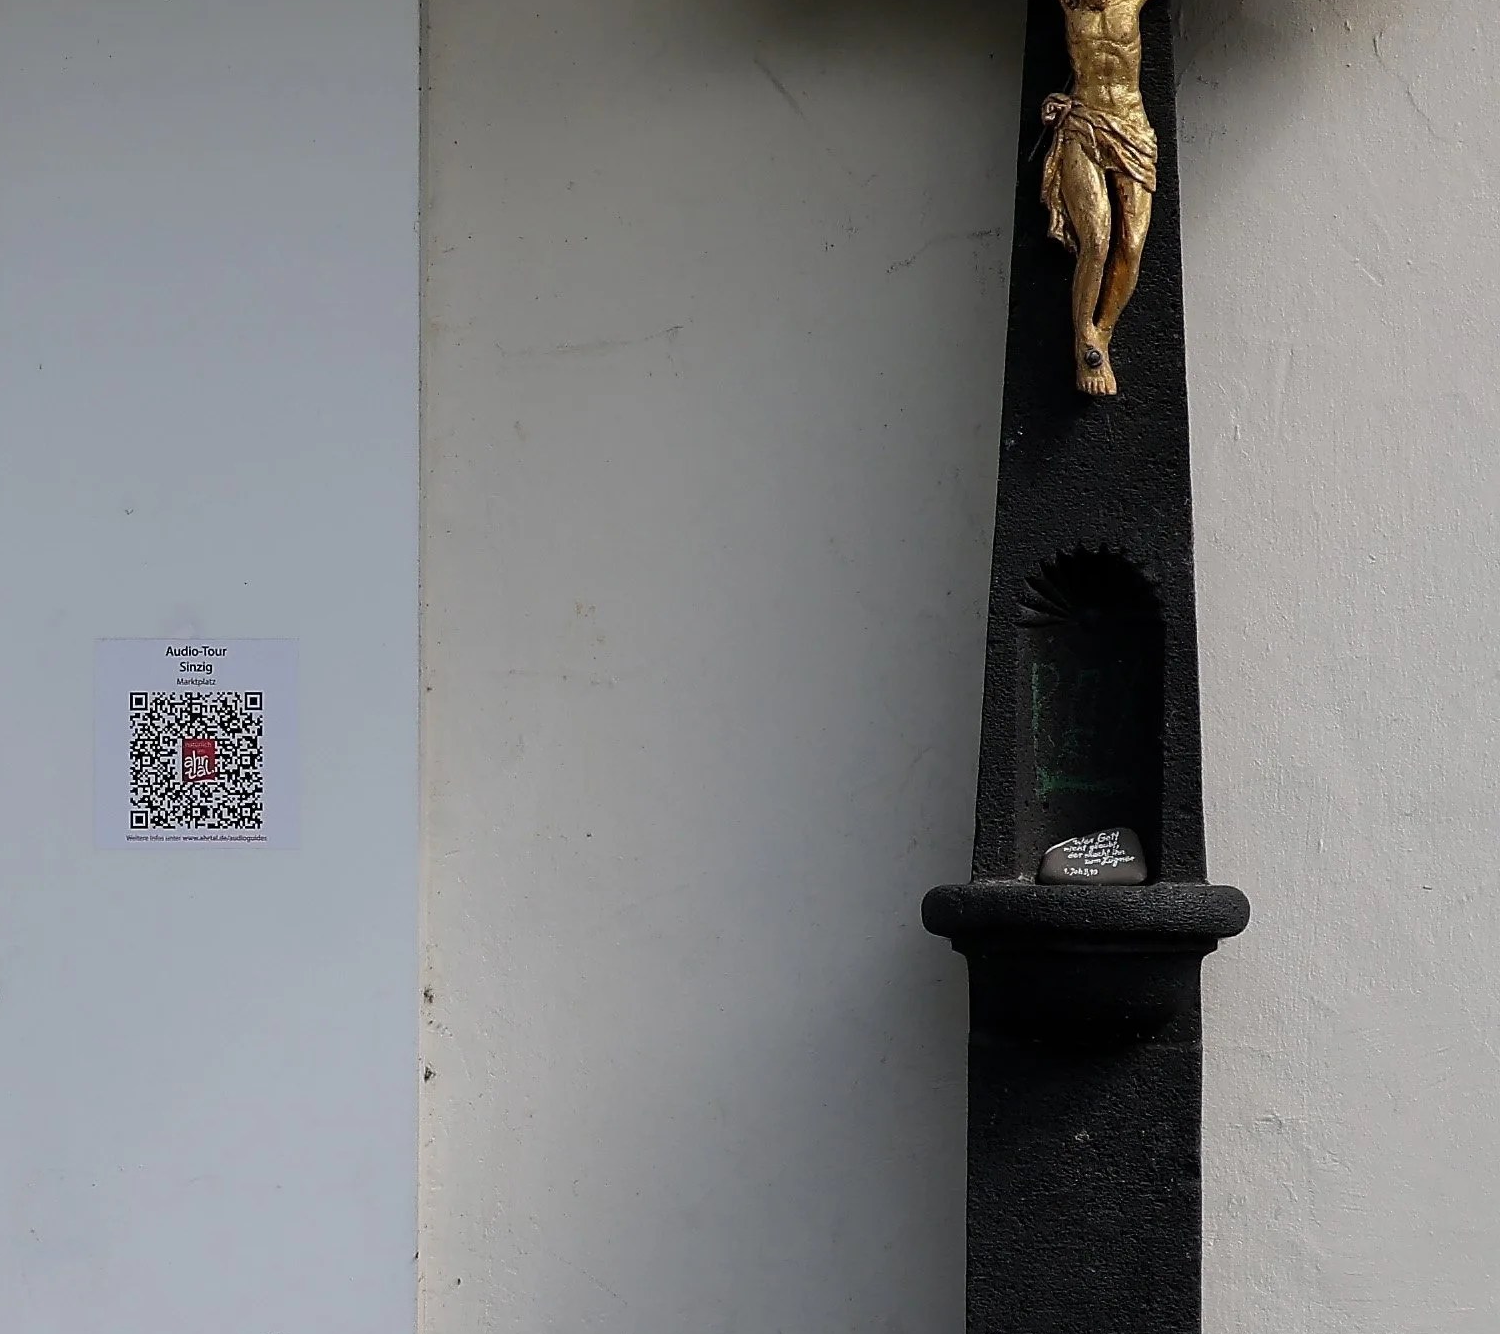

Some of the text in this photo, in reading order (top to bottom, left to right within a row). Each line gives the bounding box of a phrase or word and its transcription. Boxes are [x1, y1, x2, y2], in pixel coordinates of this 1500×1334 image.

[165, 645, 228, 657] Audio-Tour
[179, 661, 214, 675] Sinzig
[176, 677, 217, 686] Marktplatz
